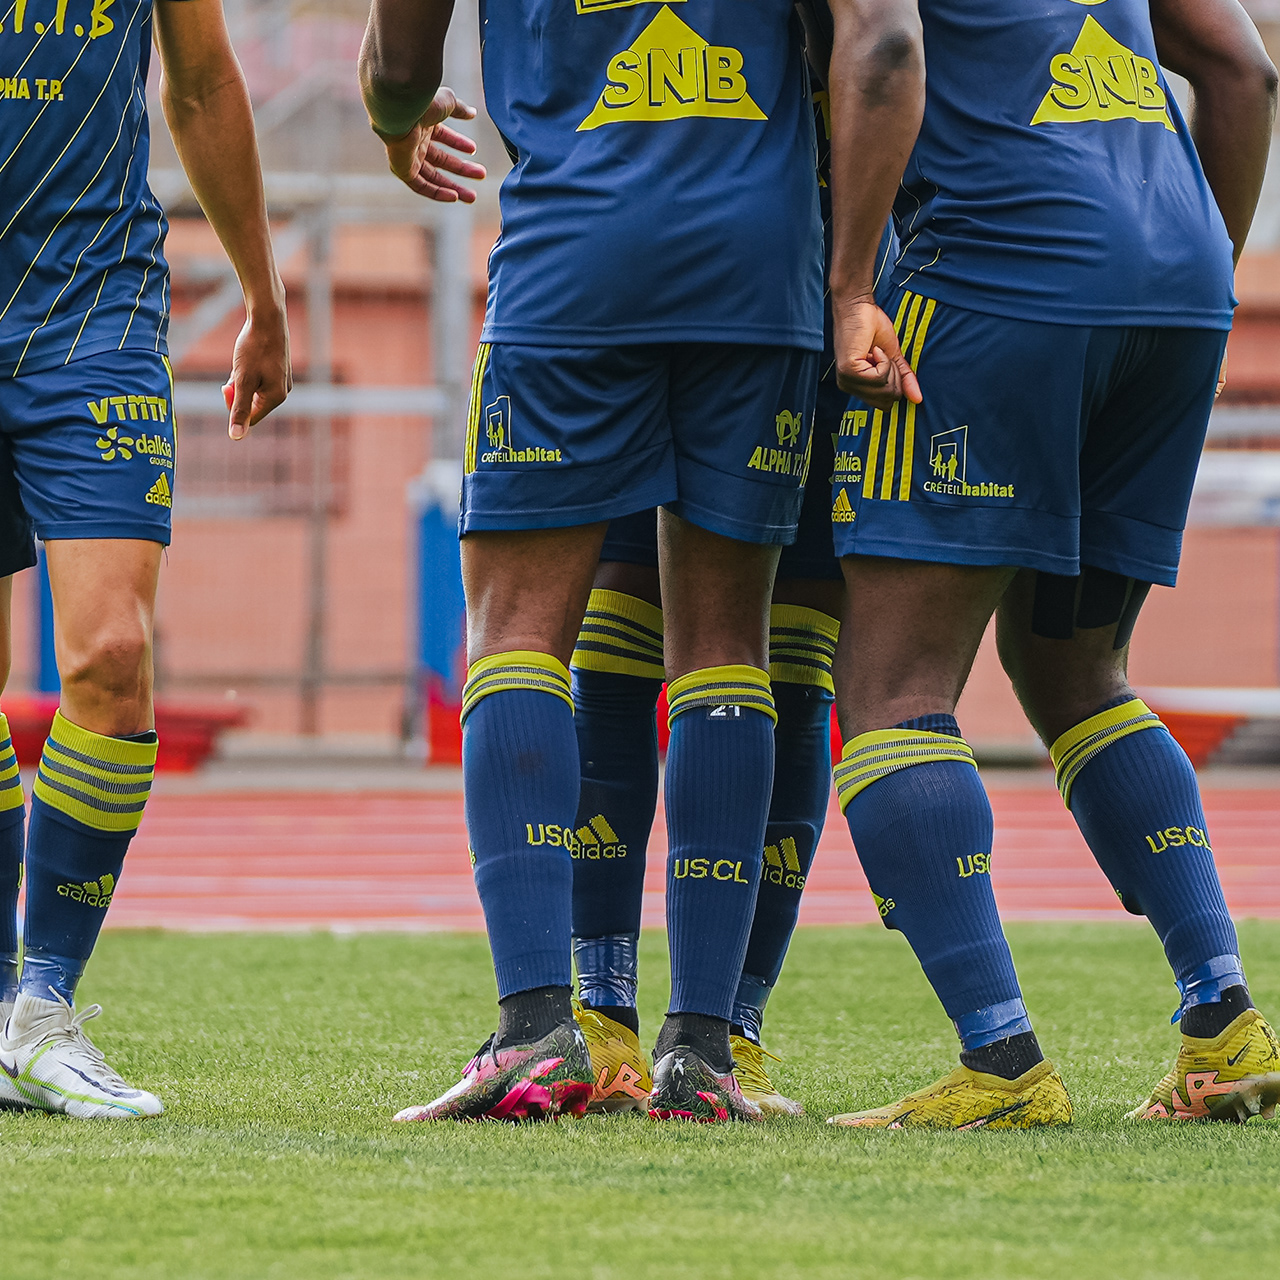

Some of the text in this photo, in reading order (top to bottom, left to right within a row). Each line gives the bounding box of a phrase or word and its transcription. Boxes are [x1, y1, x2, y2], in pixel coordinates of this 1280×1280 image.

[35, 78, 64, 101] T.P.
[602, 45, 748, 108] SNB
[1049, 51, 1167, 110] SNB
[86, 395, 168, 425] VTMTP
[135, 433, 173, 458] dalkia
[746, 445, 791, 475] ALPHA
[833, 451, 862, 472] alkia
[1145, 825, 1213, 854] USCL
[674, 857, 749, 885] USCL
